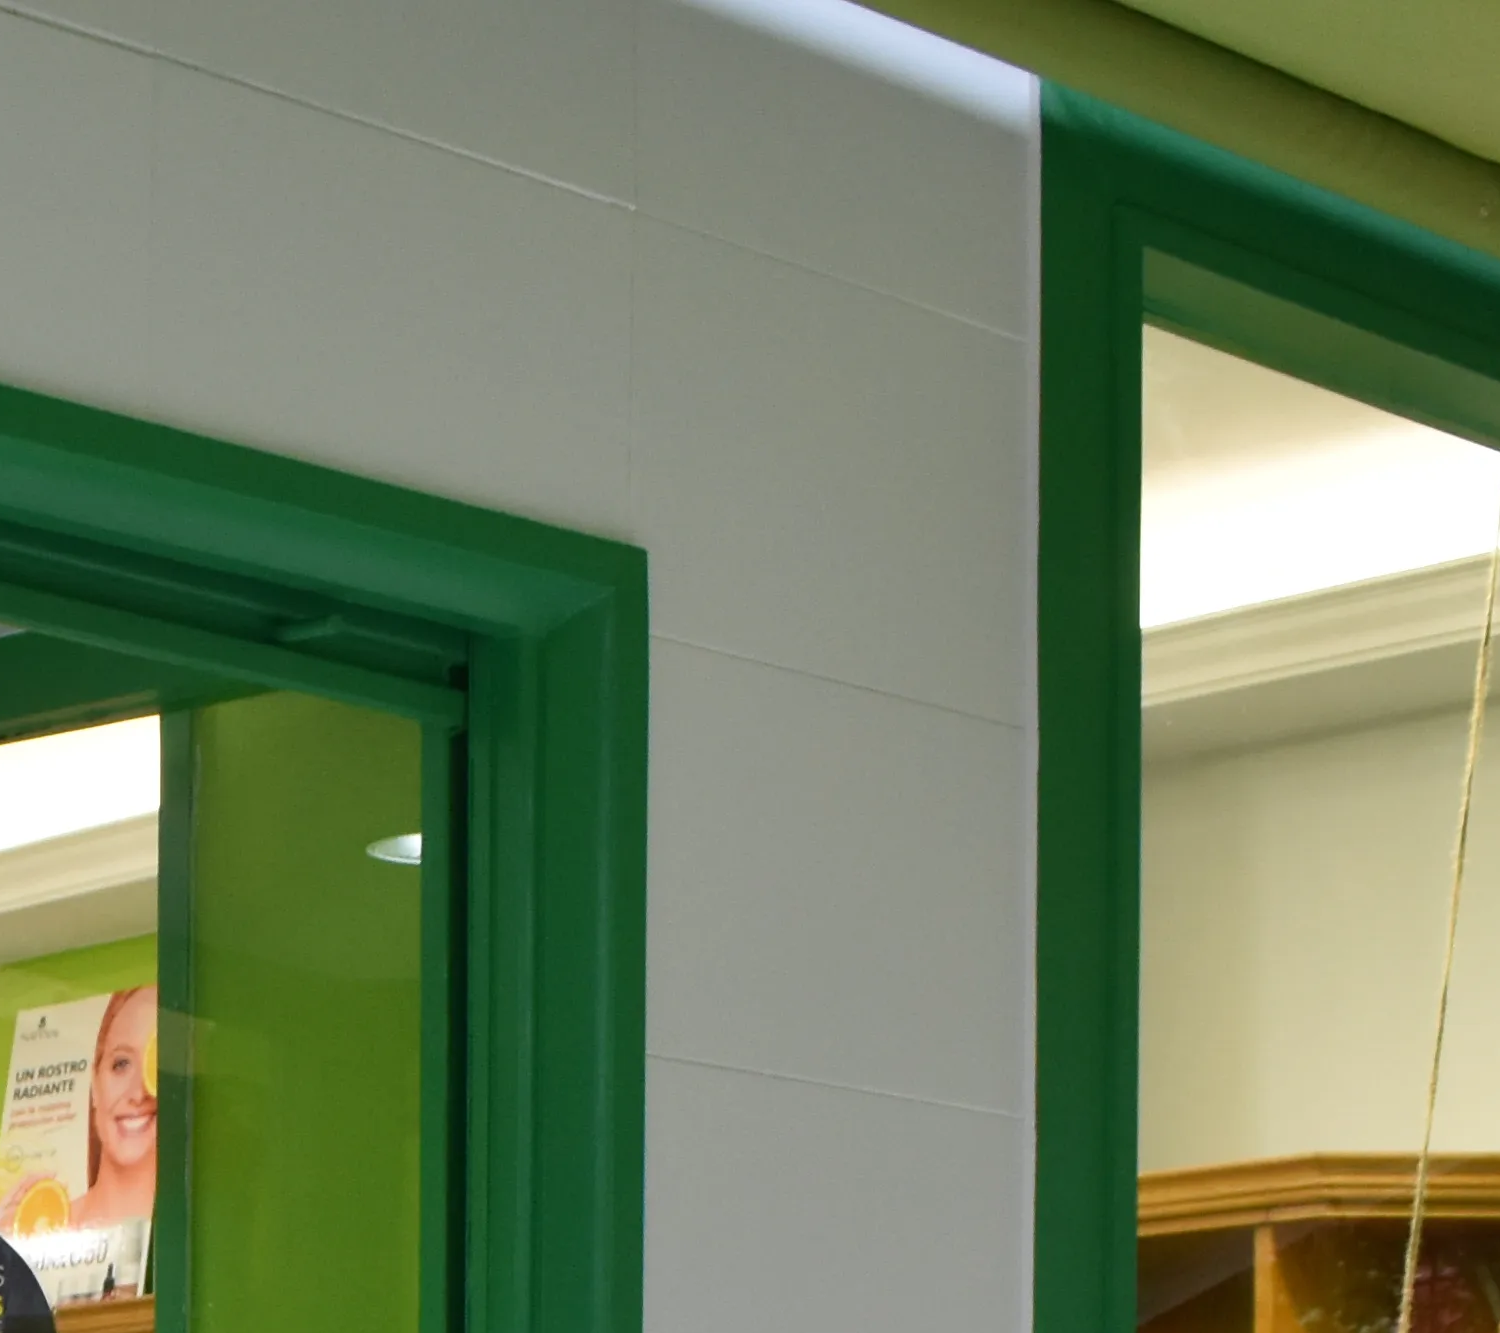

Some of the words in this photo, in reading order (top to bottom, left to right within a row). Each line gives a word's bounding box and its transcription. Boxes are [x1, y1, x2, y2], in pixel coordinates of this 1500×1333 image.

[15, 1068, 35, 1083] UN
[37, 1059, 88, 1079] ROSTRO
[12, 1078, 75, 1101] RADIANTE
